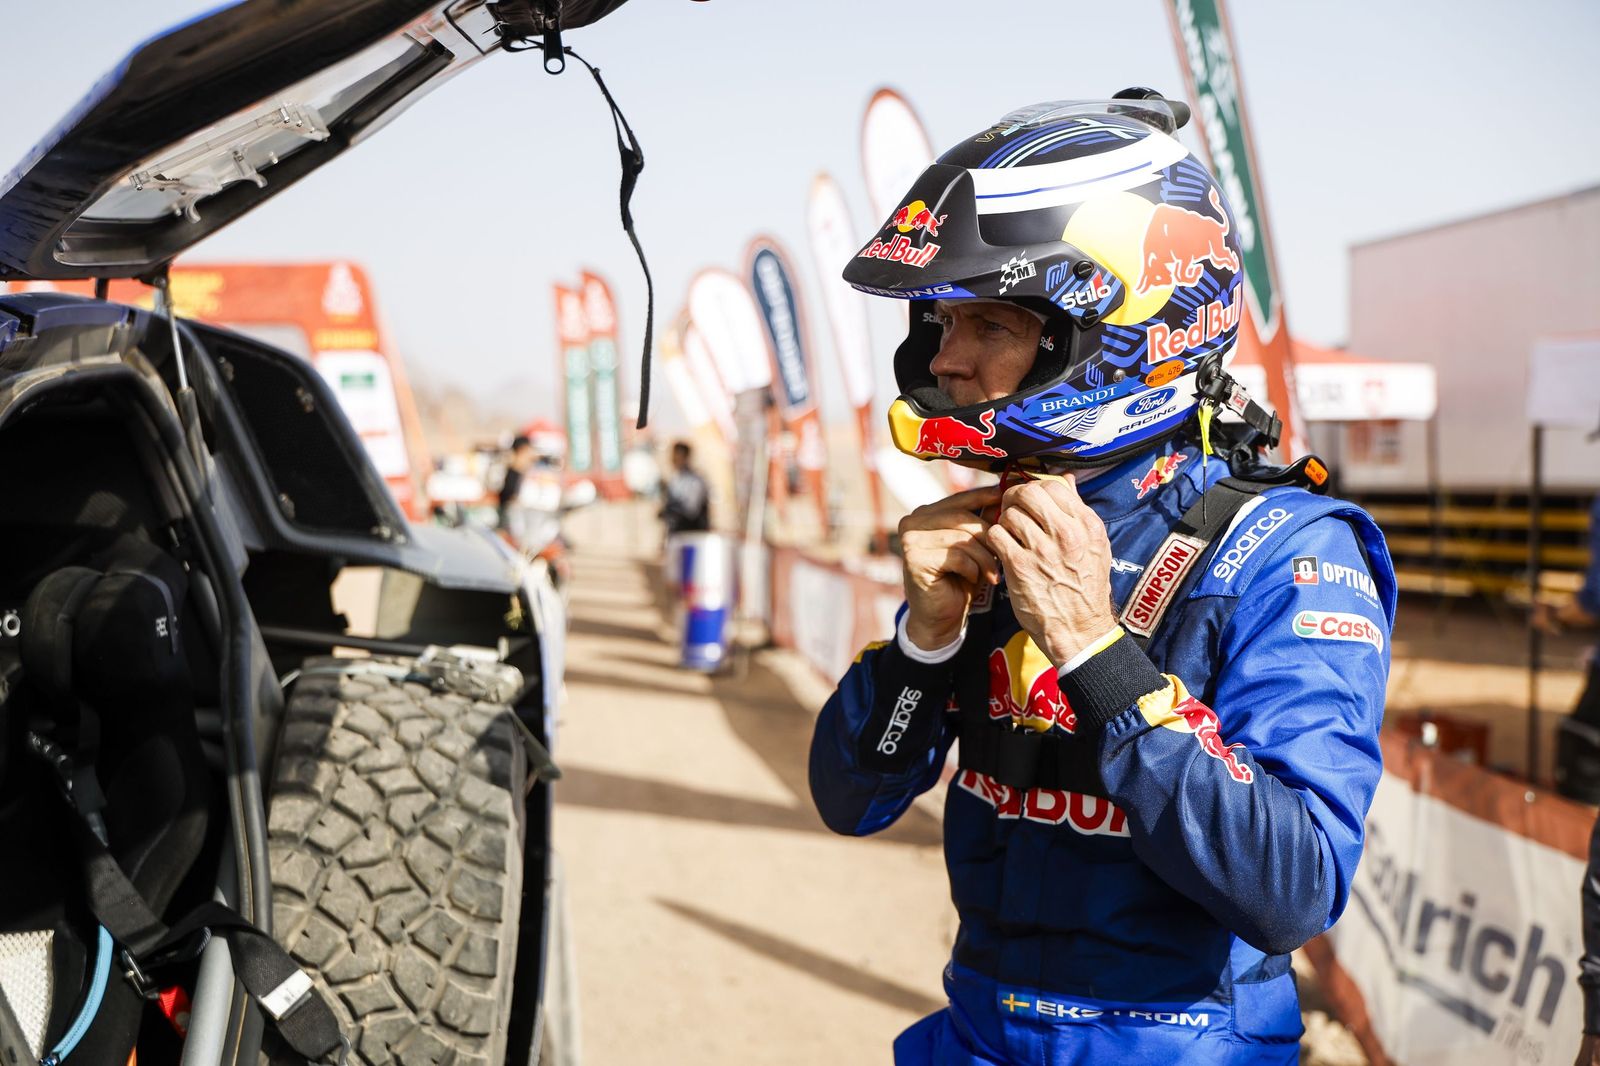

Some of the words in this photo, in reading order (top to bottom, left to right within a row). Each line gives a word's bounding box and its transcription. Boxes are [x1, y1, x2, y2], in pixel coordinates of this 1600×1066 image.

[887, 236, 941, 268] Bull
[1061, 278, 1112, 310] Stilo
[1147, 305, 1205, 365] Red
[1206, 283, 1241, 342] Bull
[1041, 386, 1117, 412] BRANDT
[1134, 393, 1167, 414] Ford
[1118, 405, 1177, 433] RACING
[1213, 508, 1293, 583] sparco
[1133, 546, 1189, 623] SIMPSON
[1322, 561, 1378, 601] OPTIMA
[877, 686, 922, 755] sparco
